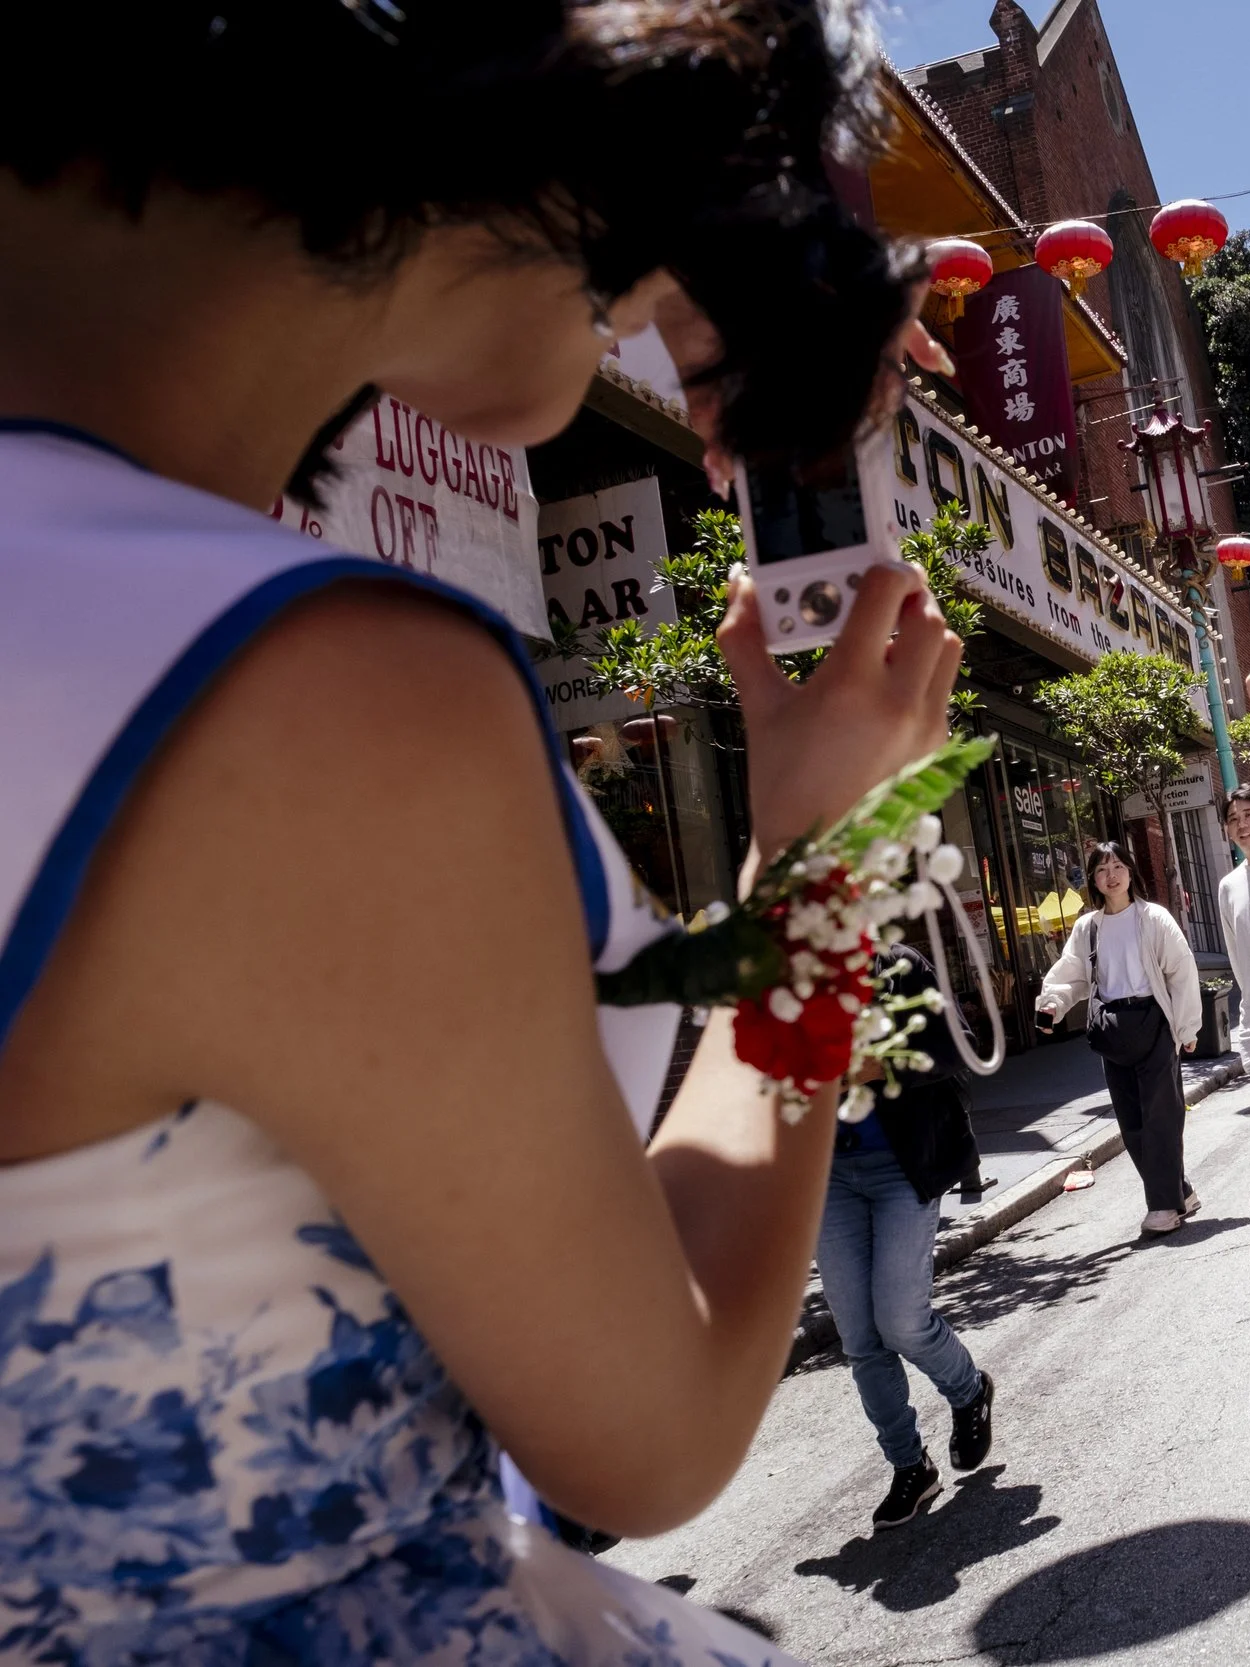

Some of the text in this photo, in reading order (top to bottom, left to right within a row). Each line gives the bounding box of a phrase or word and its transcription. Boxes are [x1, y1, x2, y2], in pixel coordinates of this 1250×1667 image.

[991, 295, 1036, 422] 廣東商場
[372, 398, 520, 523] LUGGAGE
[371, 485, 440, 579] OFF
[1038, 516, 1194, 673] BAZAAR
[946, 545, 1035, 607] easures
[1047, 592, 1082, 636] from
[1091, 622, 1112, 654] the
